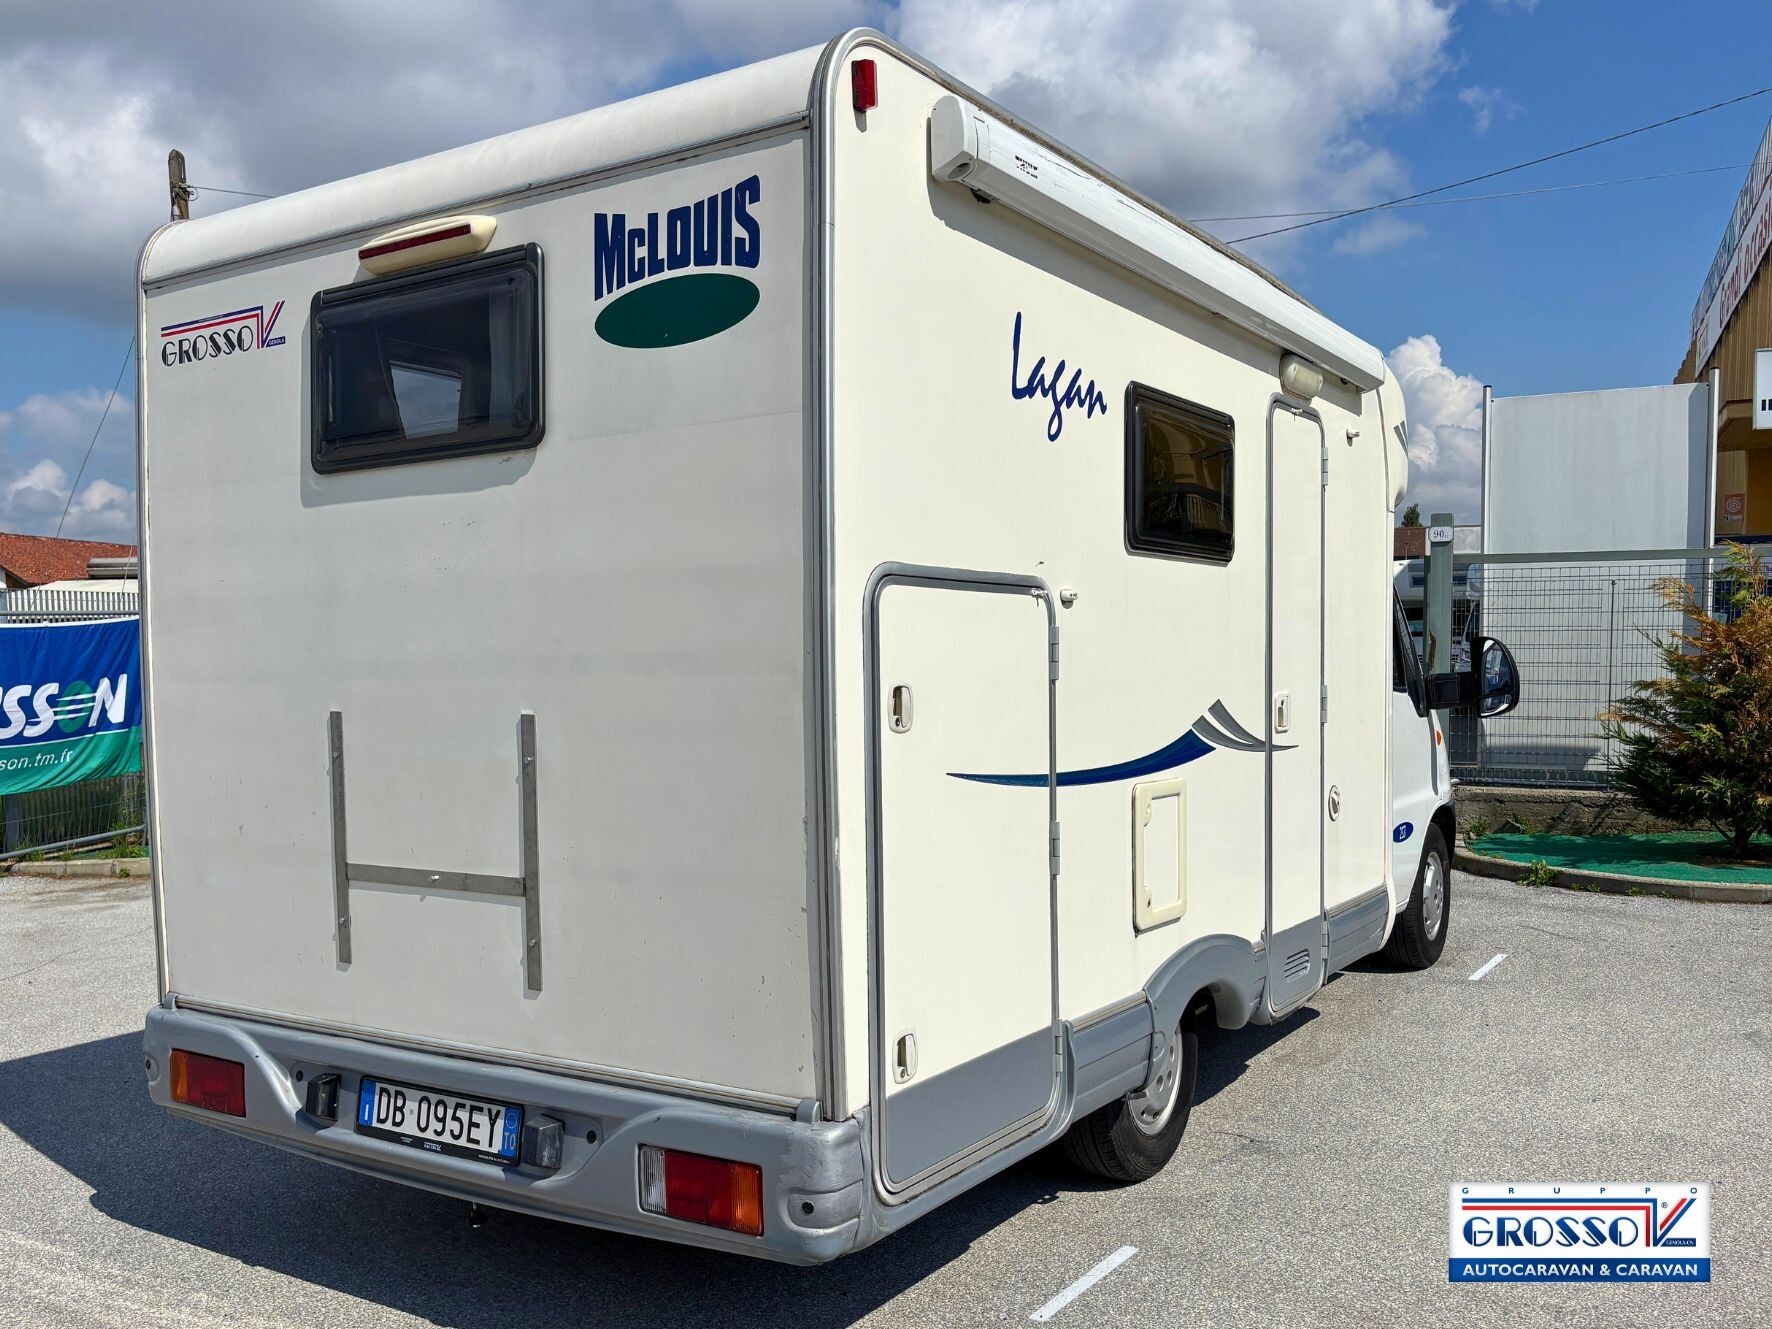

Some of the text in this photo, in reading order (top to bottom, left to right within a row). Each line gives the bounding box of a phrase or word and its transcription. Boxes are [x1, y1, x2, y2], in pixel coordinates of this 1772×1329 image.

[594, 175, 760, 301] McLOUIS
[1744, 178, 1772, 283] occasi
[162, 325, 254, 367] GROSSO
[1012, 311, 1107, 442] Lagan
[0, 674, 127, 740] SSON
[376, 1086, 407, 1127] DB
[416, 1096, 502, 1148] 095EY
[504, 1132, 516, 1150] TO
